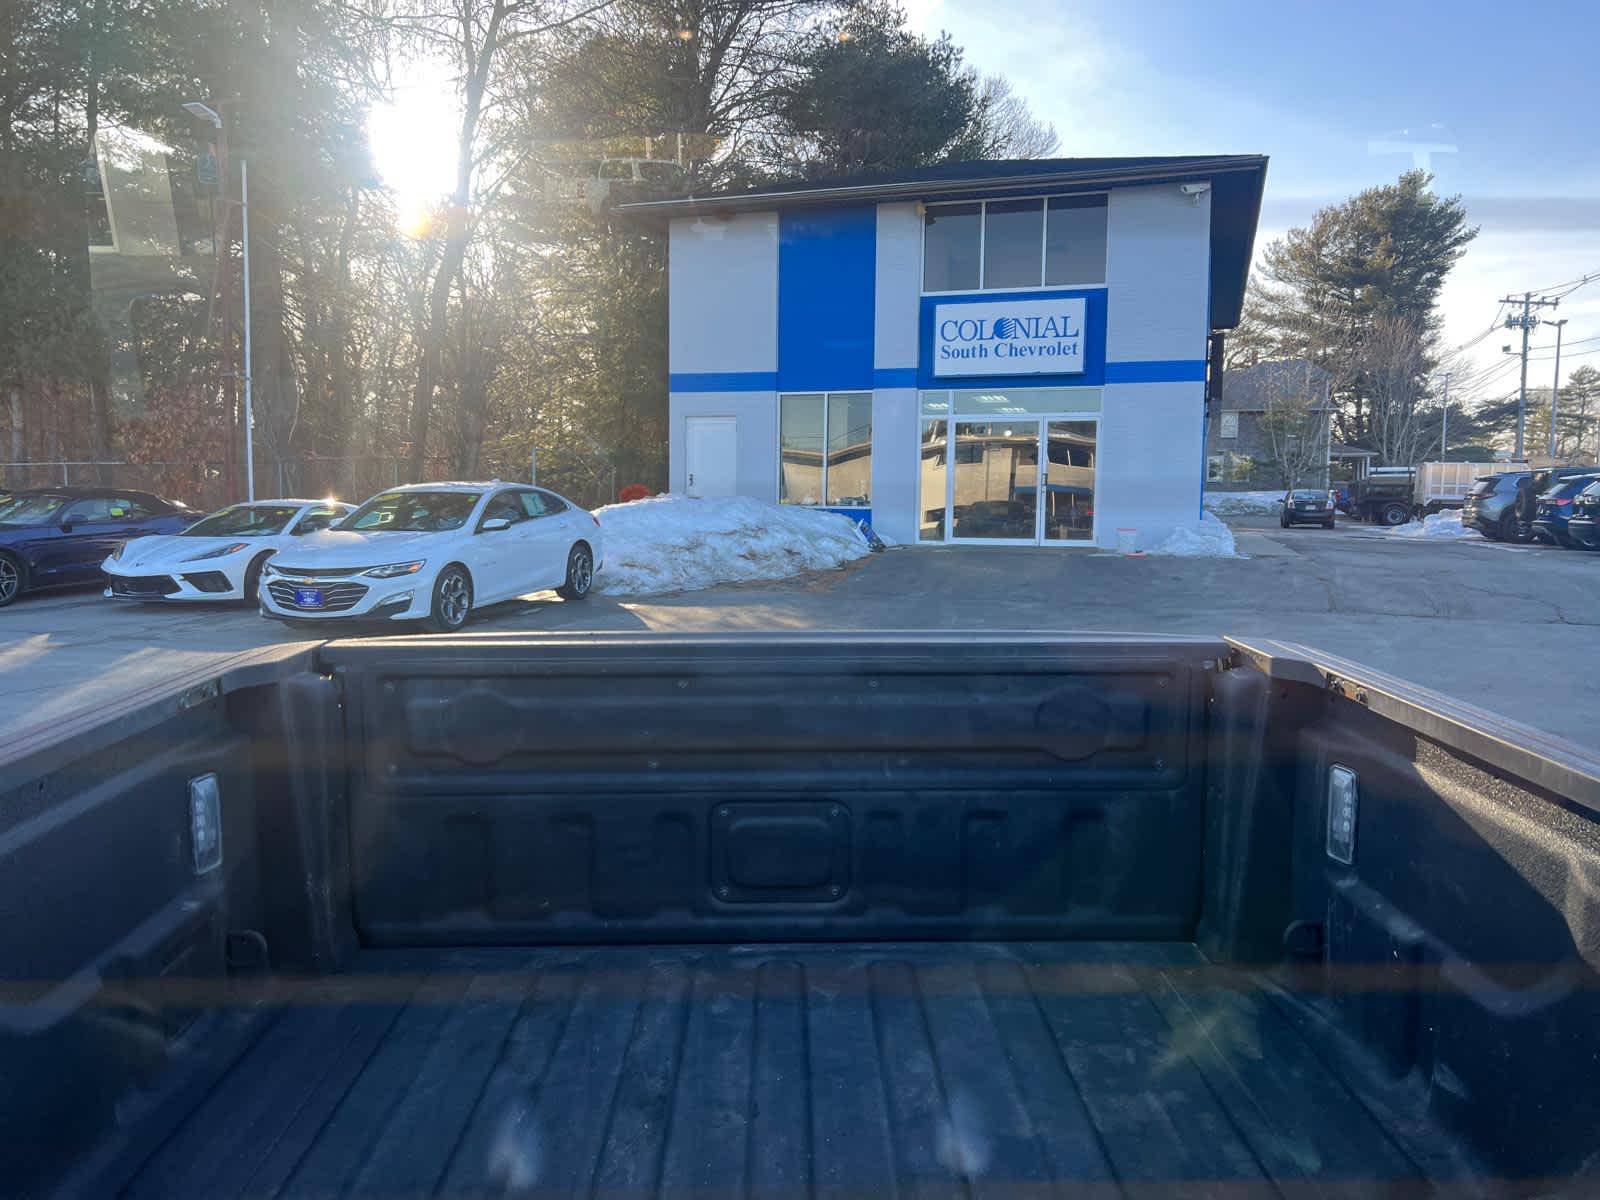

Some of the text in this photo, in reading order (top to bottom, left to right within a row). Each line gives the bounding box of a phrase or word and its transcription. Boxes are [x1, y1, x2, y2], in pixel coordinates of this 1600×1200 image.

[940, 315, 1080, 342] COLONIAL
[940, 341, 1079, 359] South Chevrolet
